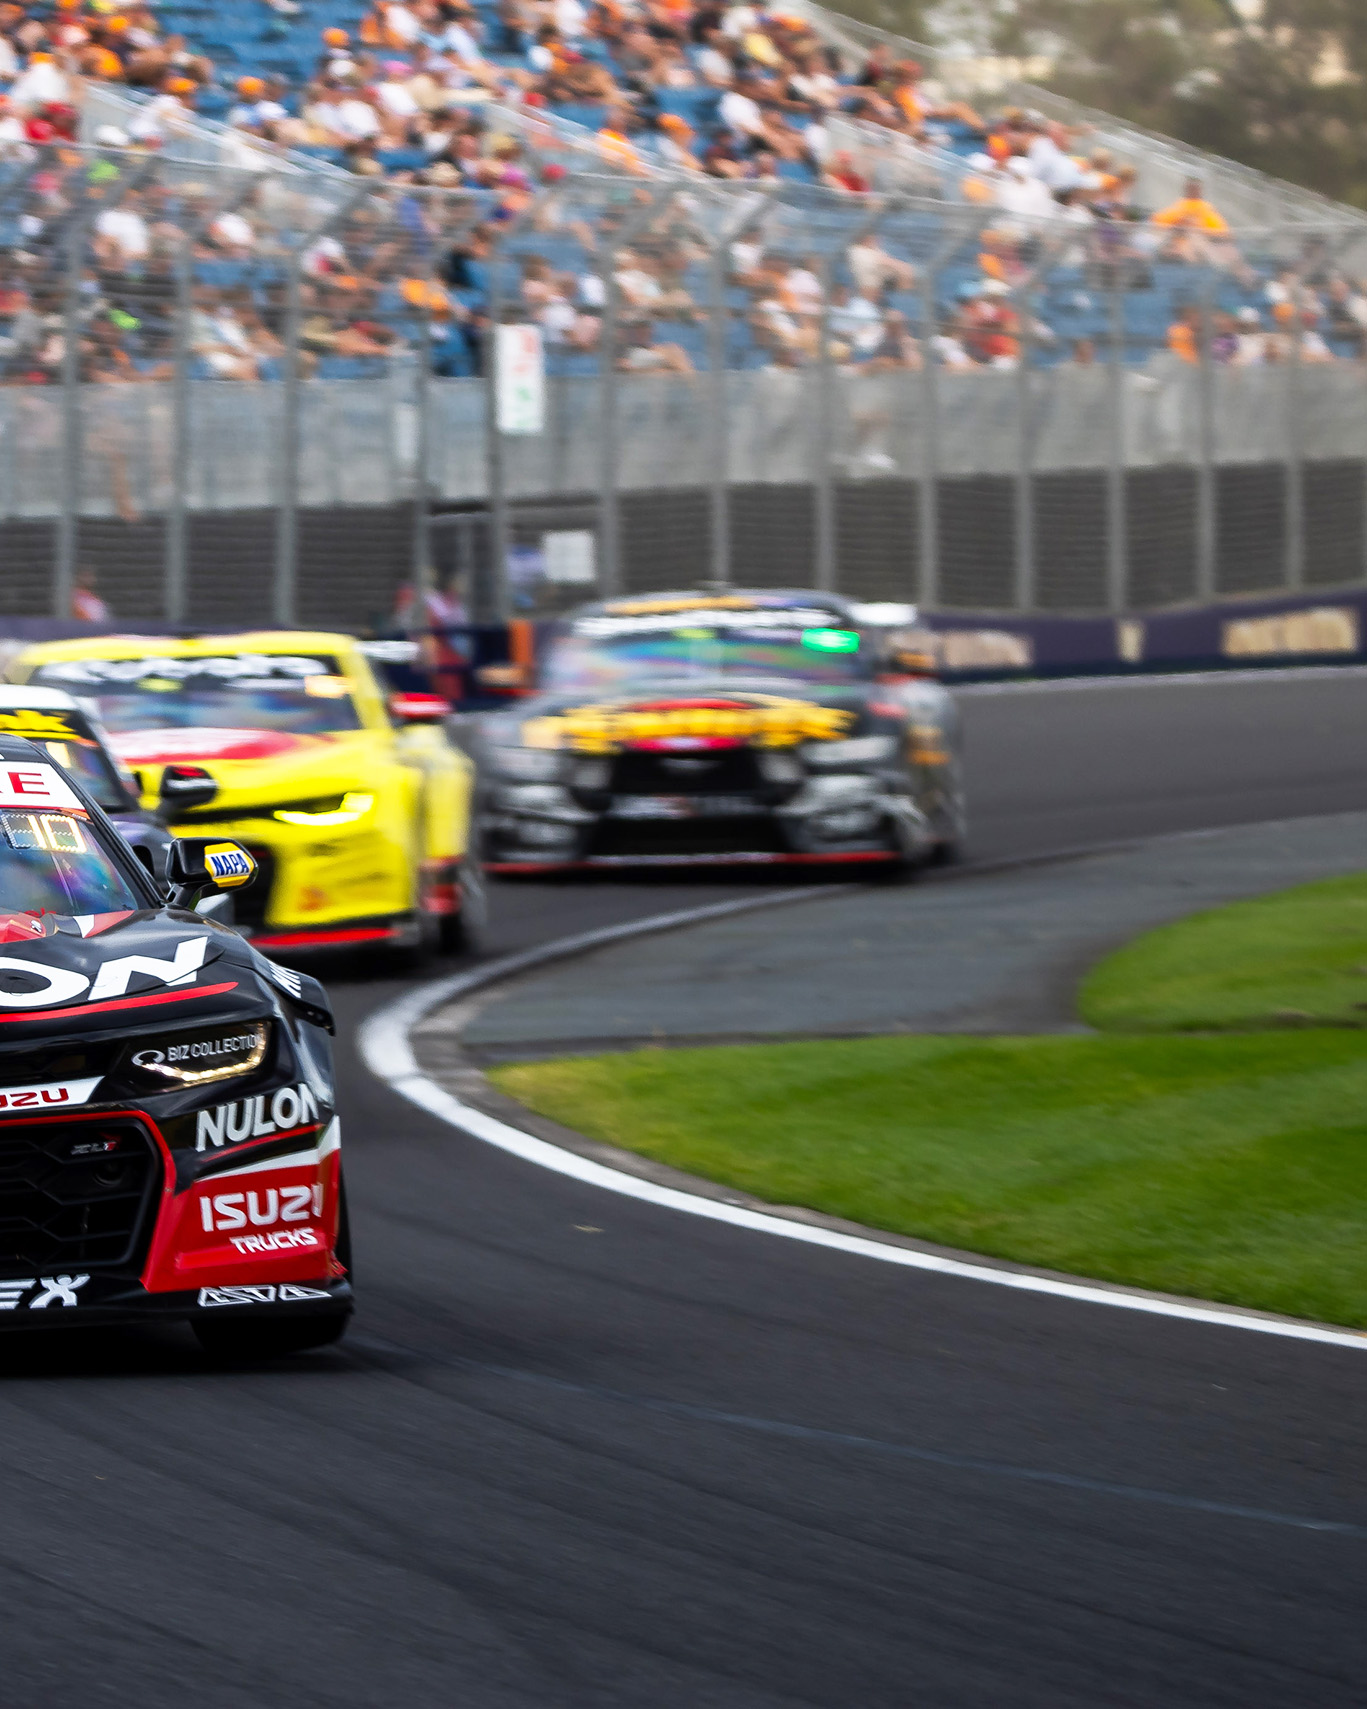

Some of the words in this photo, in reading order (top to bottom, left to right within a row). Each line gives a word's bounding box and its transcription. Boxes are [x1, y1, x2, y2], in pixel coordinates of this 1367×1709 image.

[210, 852, 250, 877] NAPA
[167, 1044, 191, 1062] BIZ
[195, 1083, 320, 1153] NULON
[229, 1226, 319, 1255] TRUCKS
